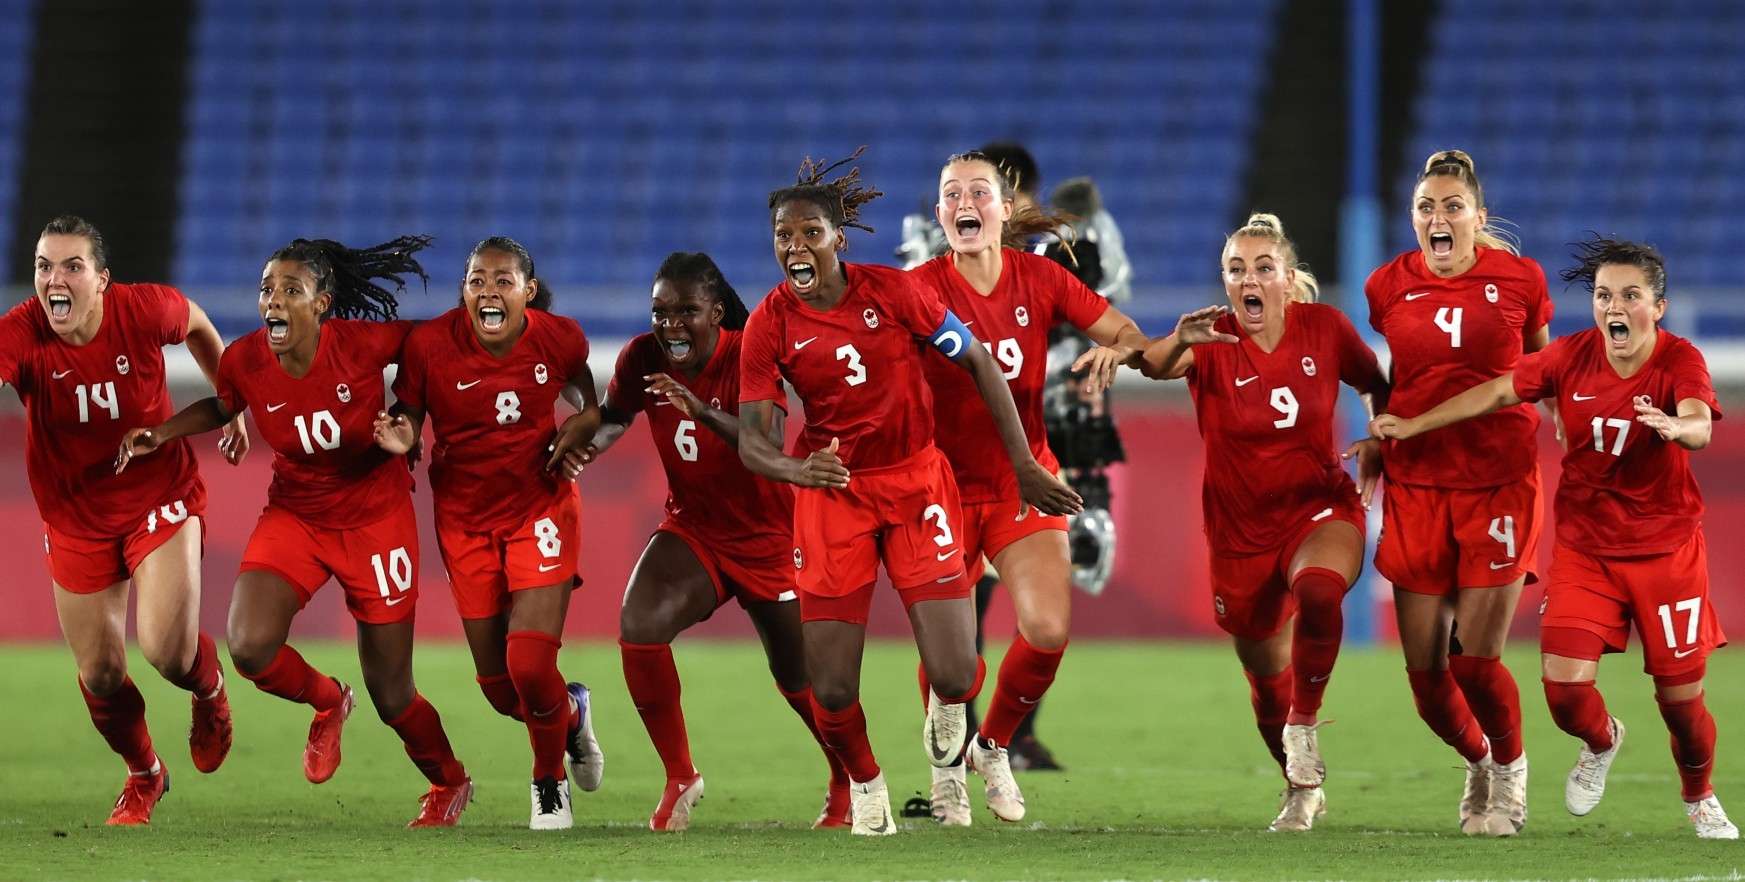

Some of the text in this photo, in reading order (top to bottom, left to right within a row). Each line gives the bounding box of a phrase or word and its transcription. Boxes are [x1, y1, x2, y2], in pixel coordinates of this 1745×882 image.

[1433, 307, 1463, 348] 4
[835, 343, 867, 387] 3
[982, 338, 1024, 381] 9
[74, 381, 120, 423] 14
[495, 390, 522, 424] 8
[1269, 386, 1300, 429] 9
[294, 409, 341, 454] 10
[673, 419, 698, 462] 6
[1591, 416, 1631, 457] 17
[534, 517, 562, 558] 8
[923, 503, 954, 548] 3
[1487, 515, 1516, 558] 4
[371, 546, 412, 597] 10
[1657, 596, 1702, 649] 17
